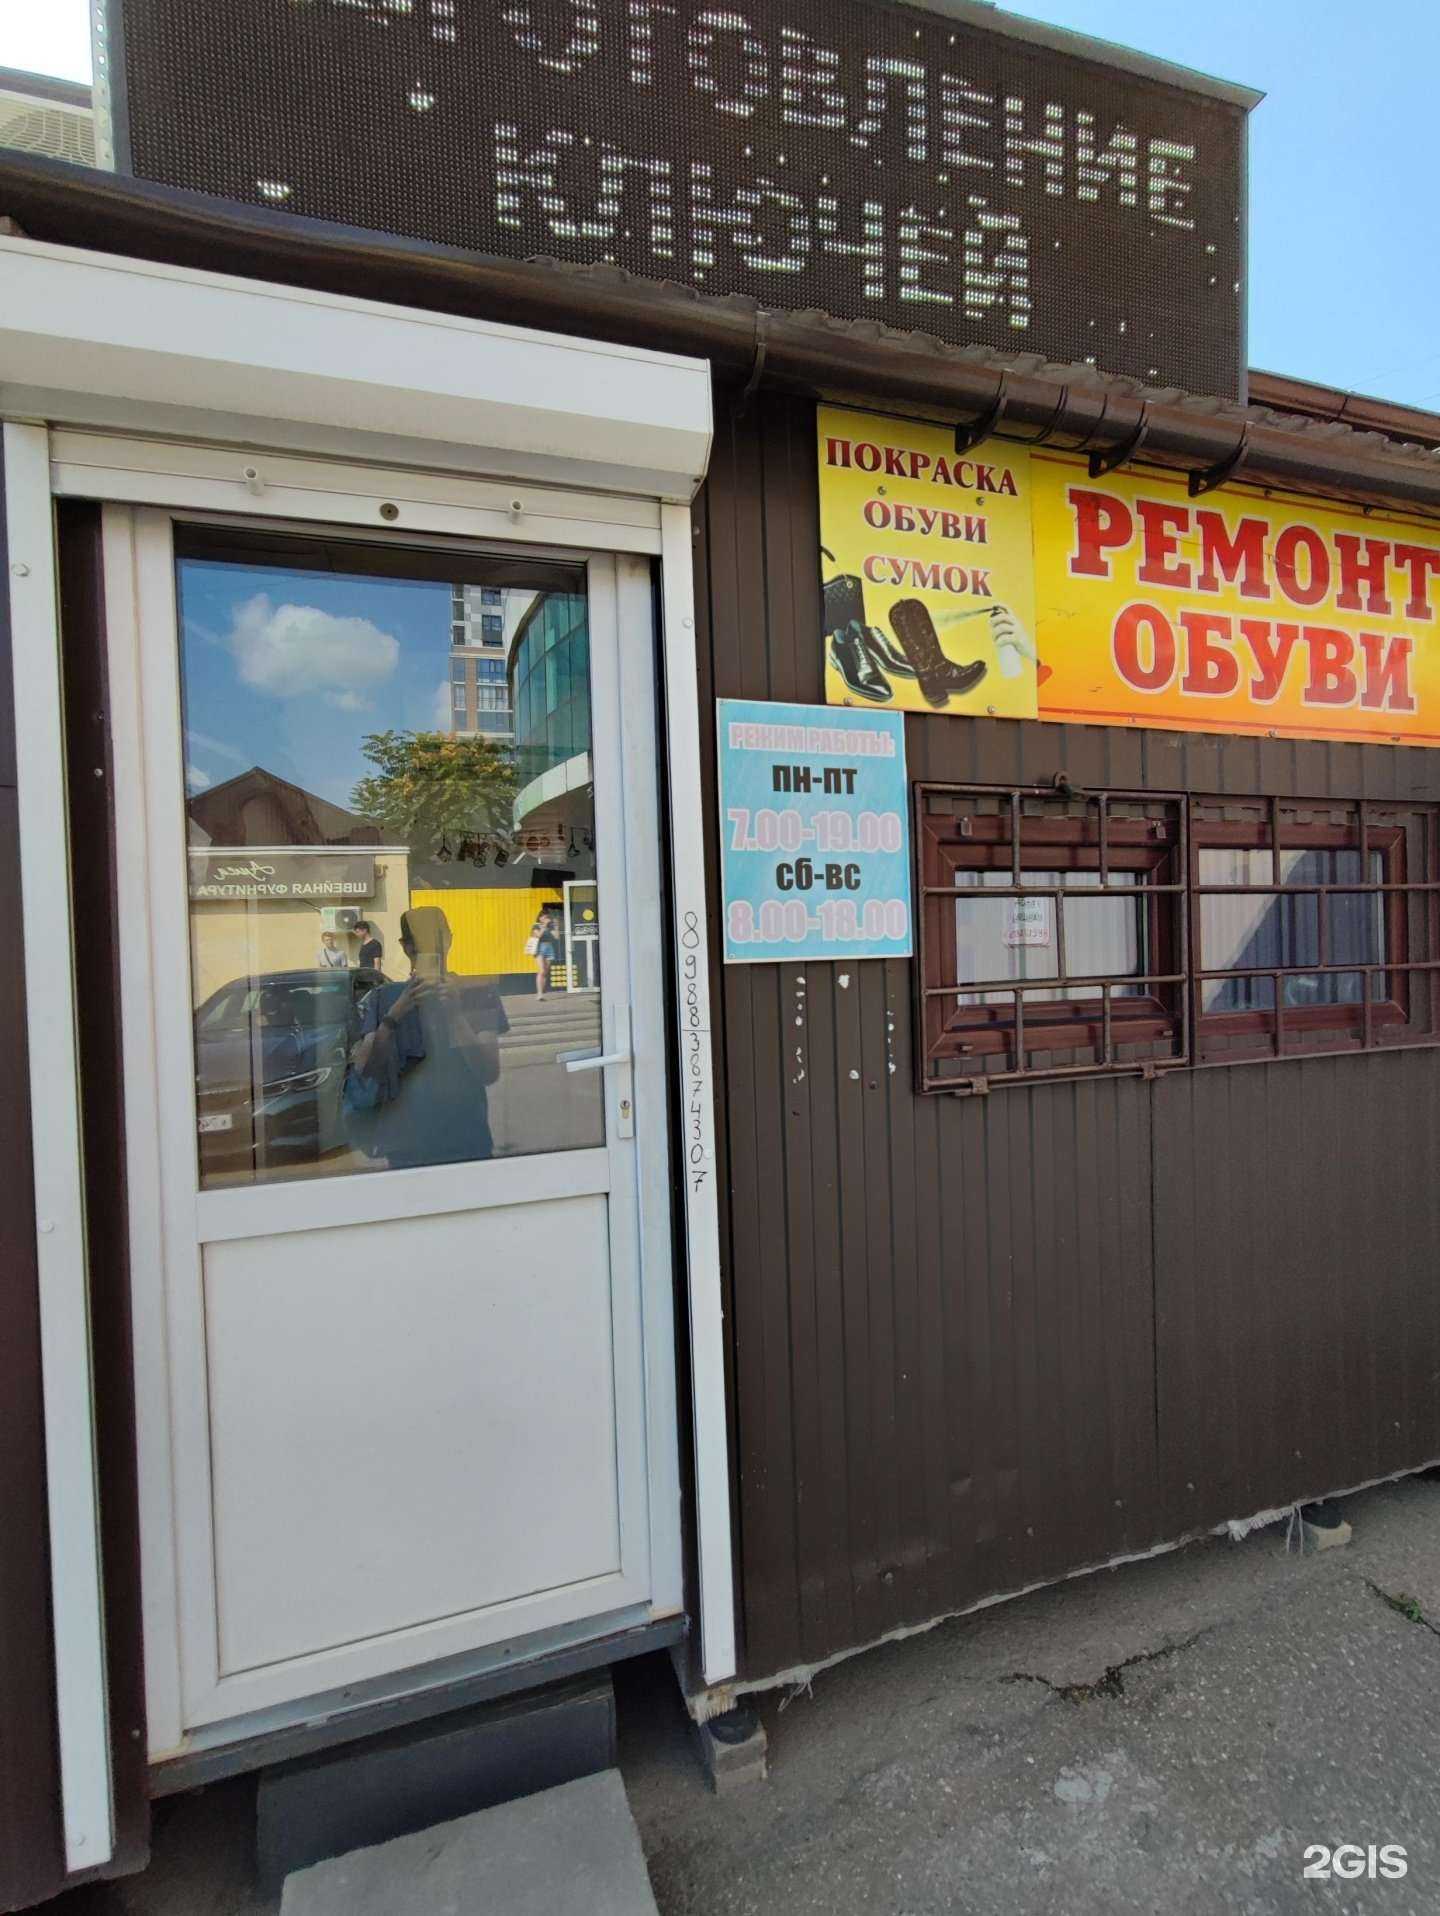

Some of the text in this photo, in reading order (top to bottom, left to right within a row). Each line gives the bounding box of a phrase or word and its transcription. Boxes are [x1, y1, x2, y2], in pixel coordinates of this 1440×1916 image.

[493, 121, 1031, 330] КЛЮЧЕЙ
[824, 437, 1018, 497] ПОКРАСКА
[863, 499, 989, 545] ОБУВИ
[863, 554, 992, 598] СУМОК
[1067, 487, 1440, 621] РЕМОНТ
[1113, 602, 1416, 713] ОБУВИ
[729, 723, 805, 753] РЕЖИМ
[728, 808, 901, 853] 7.00-19.00
[728, 899, 906, 943] 8.00-18.00
